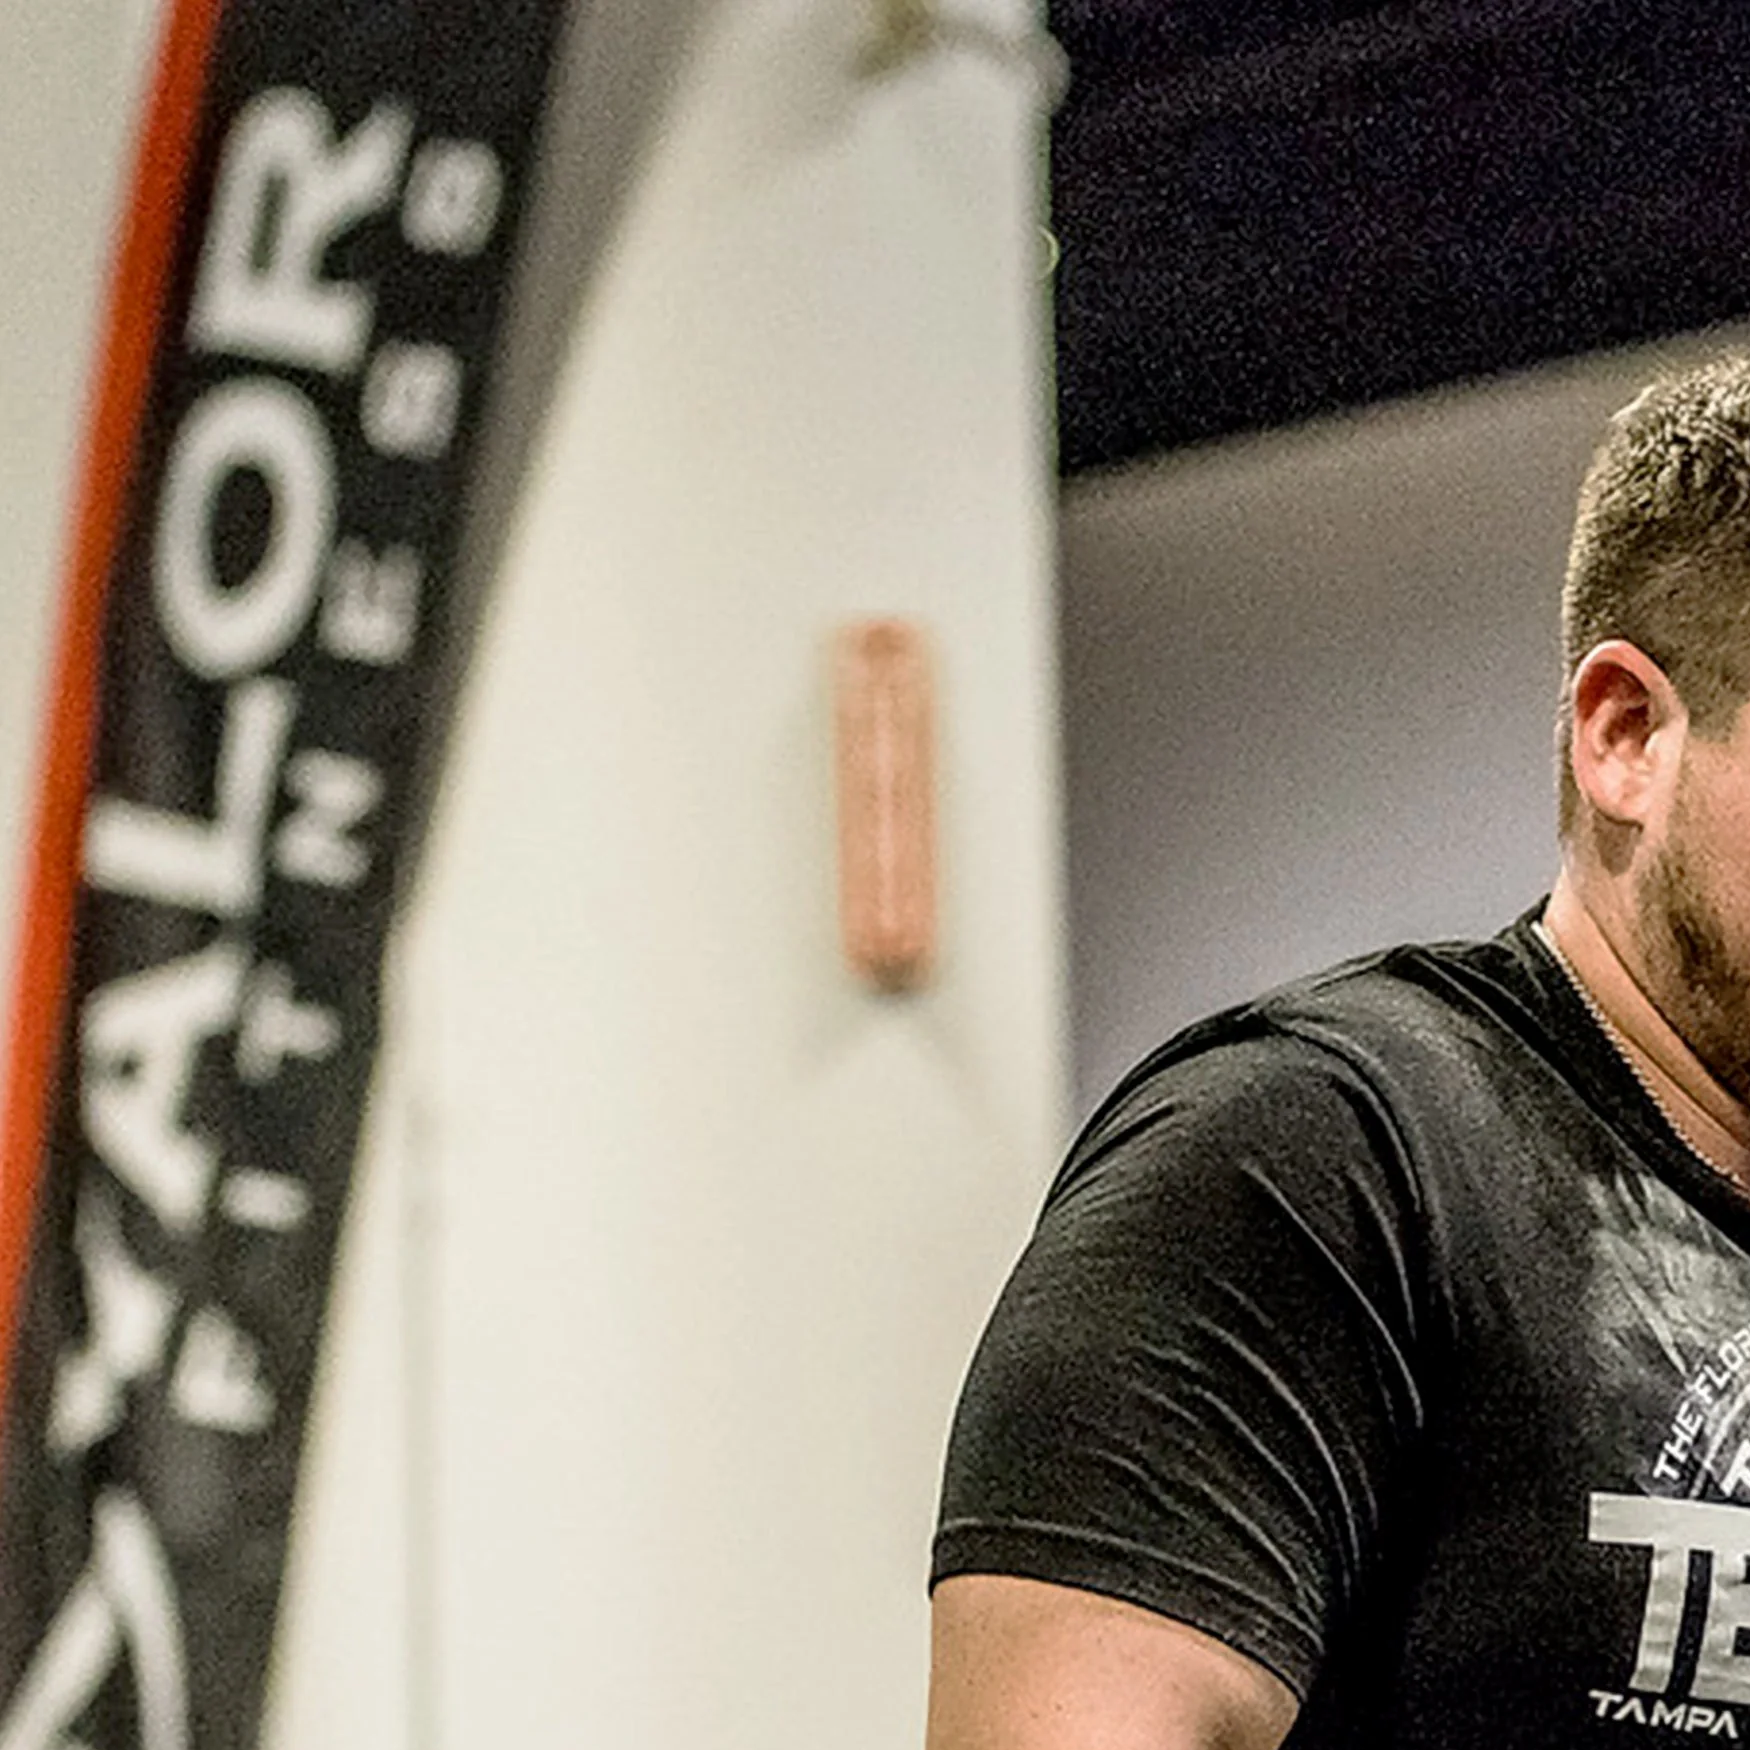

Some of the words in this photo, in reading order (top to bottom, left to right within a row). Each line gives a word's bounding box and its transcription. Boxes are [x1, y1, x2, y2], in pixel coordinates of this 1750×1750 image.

[45, 83, 414, 1456] VALOR
[1652, 1400, 1703, 1480] THE
[1588, 1690, 1739, 1740] TAMPA
